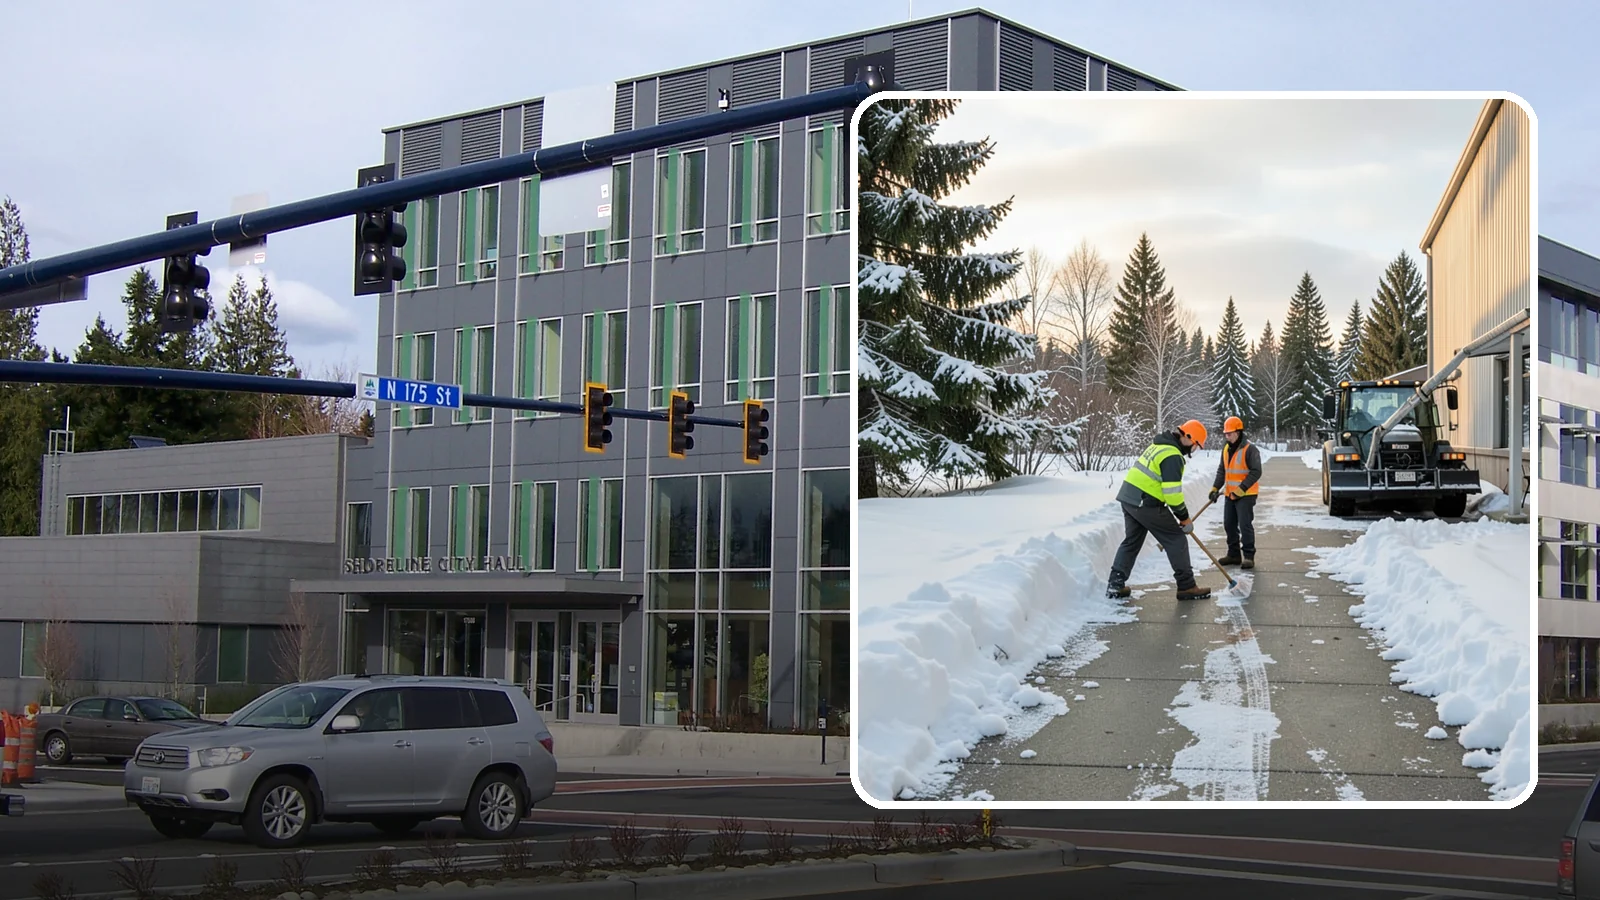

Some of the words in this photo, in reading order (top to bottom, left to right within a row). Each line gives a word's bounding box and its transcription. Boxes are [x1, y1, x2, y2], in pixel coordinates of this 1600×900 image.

[387, 380, 396, 400] N
[405, 382, 427, 403] 175
[436, 386, 451, 406] St
[344, 557, 432, 574] SHORELINE
[438, 556, 476, 573] CITY
[484, 555, 526, 572] HALL
